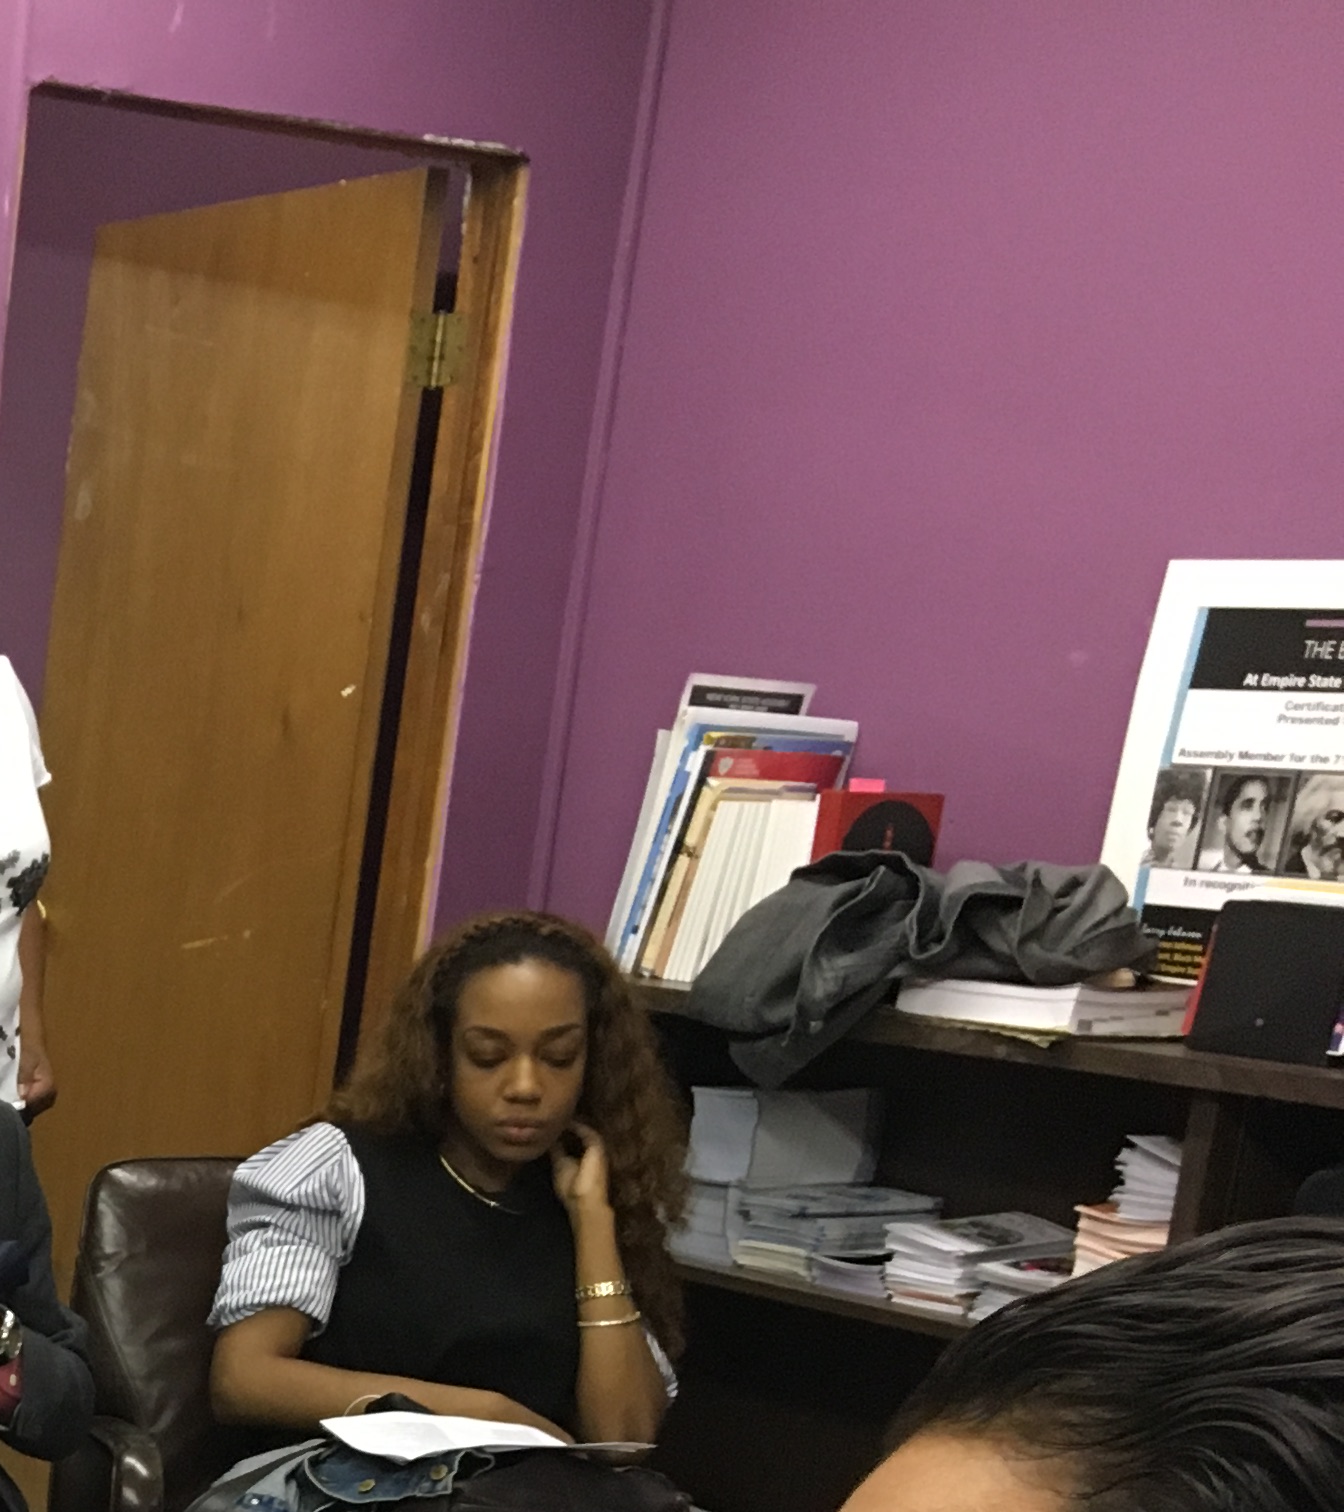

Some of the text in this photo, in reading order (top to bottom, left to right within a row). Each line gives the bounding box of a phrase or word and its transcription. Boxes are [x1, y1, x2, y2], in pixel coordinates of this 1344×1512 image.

[1304, 639, 1337, 660] THE
[1243, 672, 1343, 690] At Empire State
[1277, 713, 1340, 726] Presented
[1178, 748, 1236, 764] Assembly
[1238, 750, 1286, 763] Member
[1289, 752, 1307, 764] for
[1310, 753, 1330, 764] the
